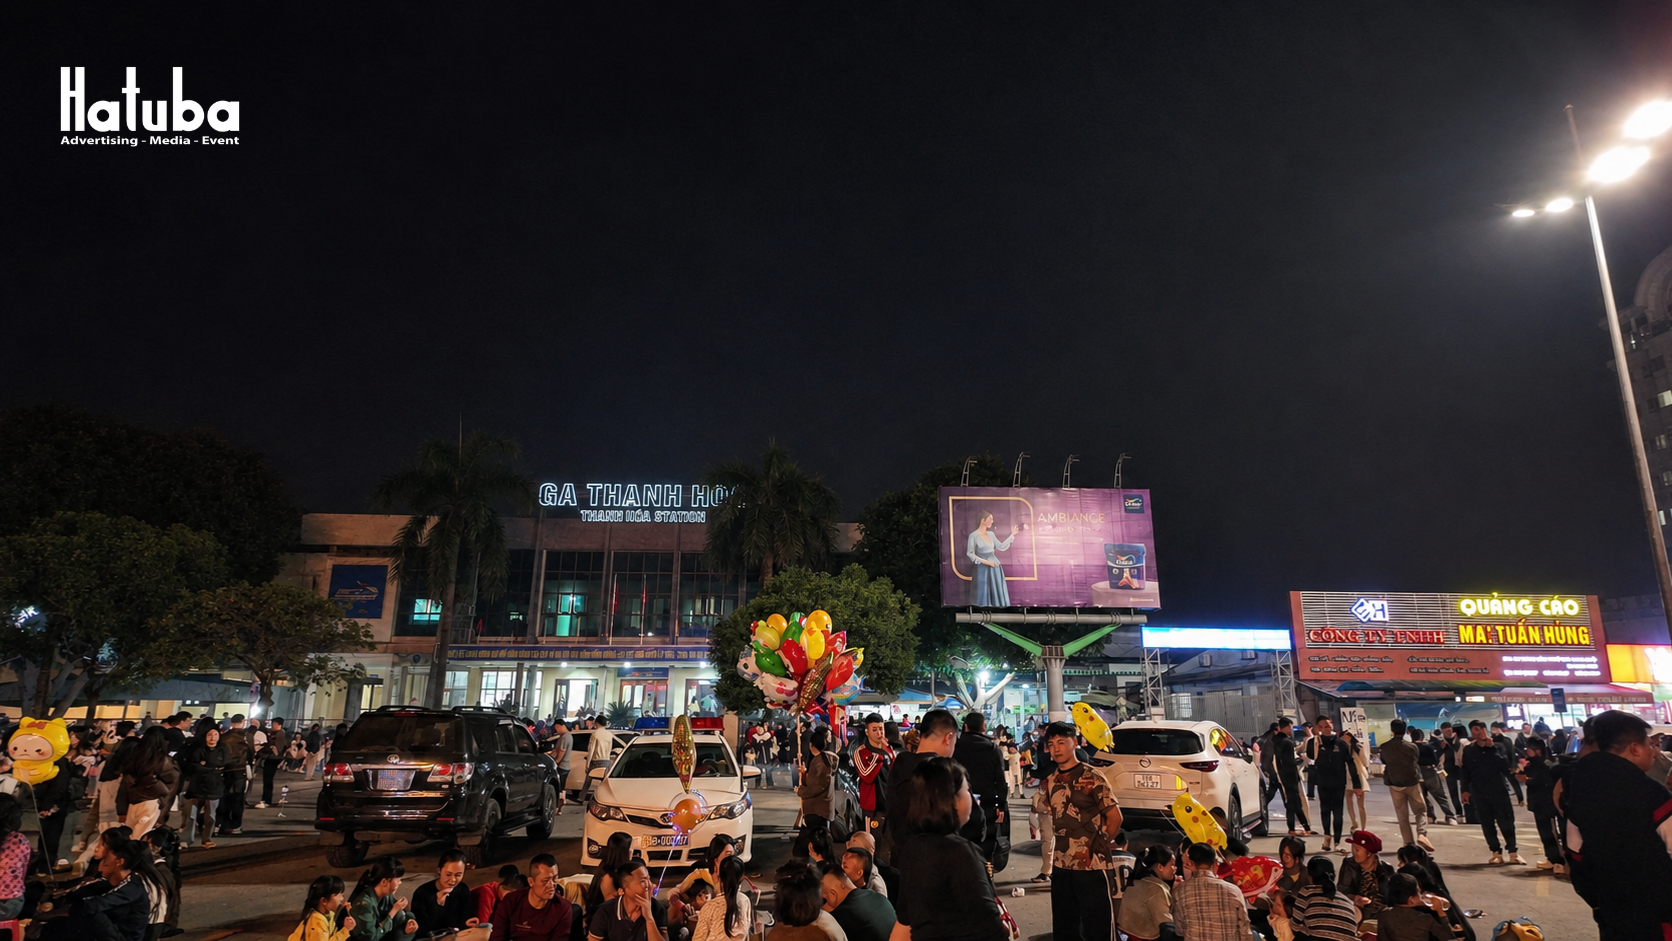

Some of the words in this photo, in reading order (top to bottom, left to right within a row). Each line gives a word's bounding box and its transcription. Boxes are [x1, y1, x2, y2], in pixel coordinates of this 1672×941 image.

[539, 483, 577, 506] GA
[587, 483, 682, 507] THANH
[580, 509, 623, 522] THANH
[654, 510, 706, 523] STATION
[1037, 512, 1105, 523] AMBIANCE
[1459, 592, 1534, 617] QUẢNG
[1539, 595, 1580, 616] CÁO
[1495, 618, 1541, 645] TUẤN
